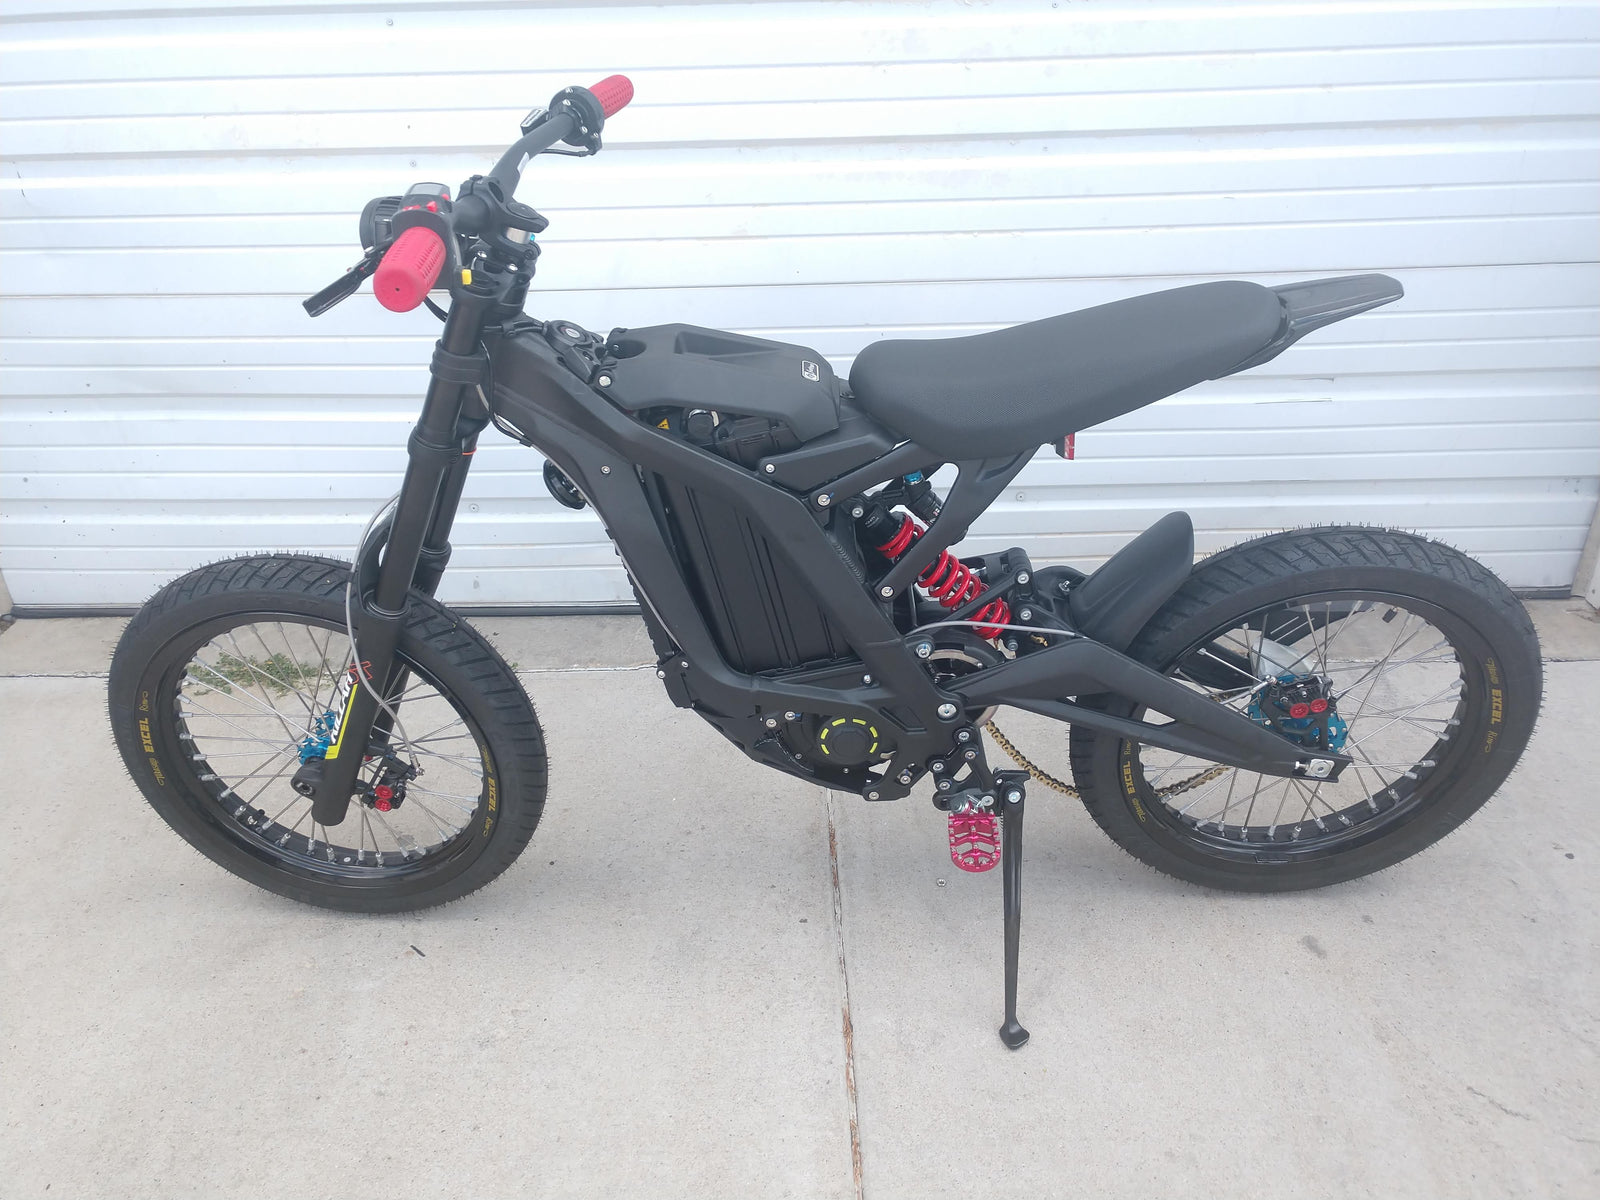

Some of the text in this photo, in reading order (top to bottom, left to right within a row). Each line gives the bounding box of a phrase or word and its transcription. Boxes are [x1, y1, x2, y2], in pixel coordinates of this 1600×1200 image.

[1491, 688, 1503, 725] EXCEL
[139, 717, 155, 753] EXCEL
[487, 776, 497, 812] EXCEL
[1123, 760, 1136, 795] EXCEL
